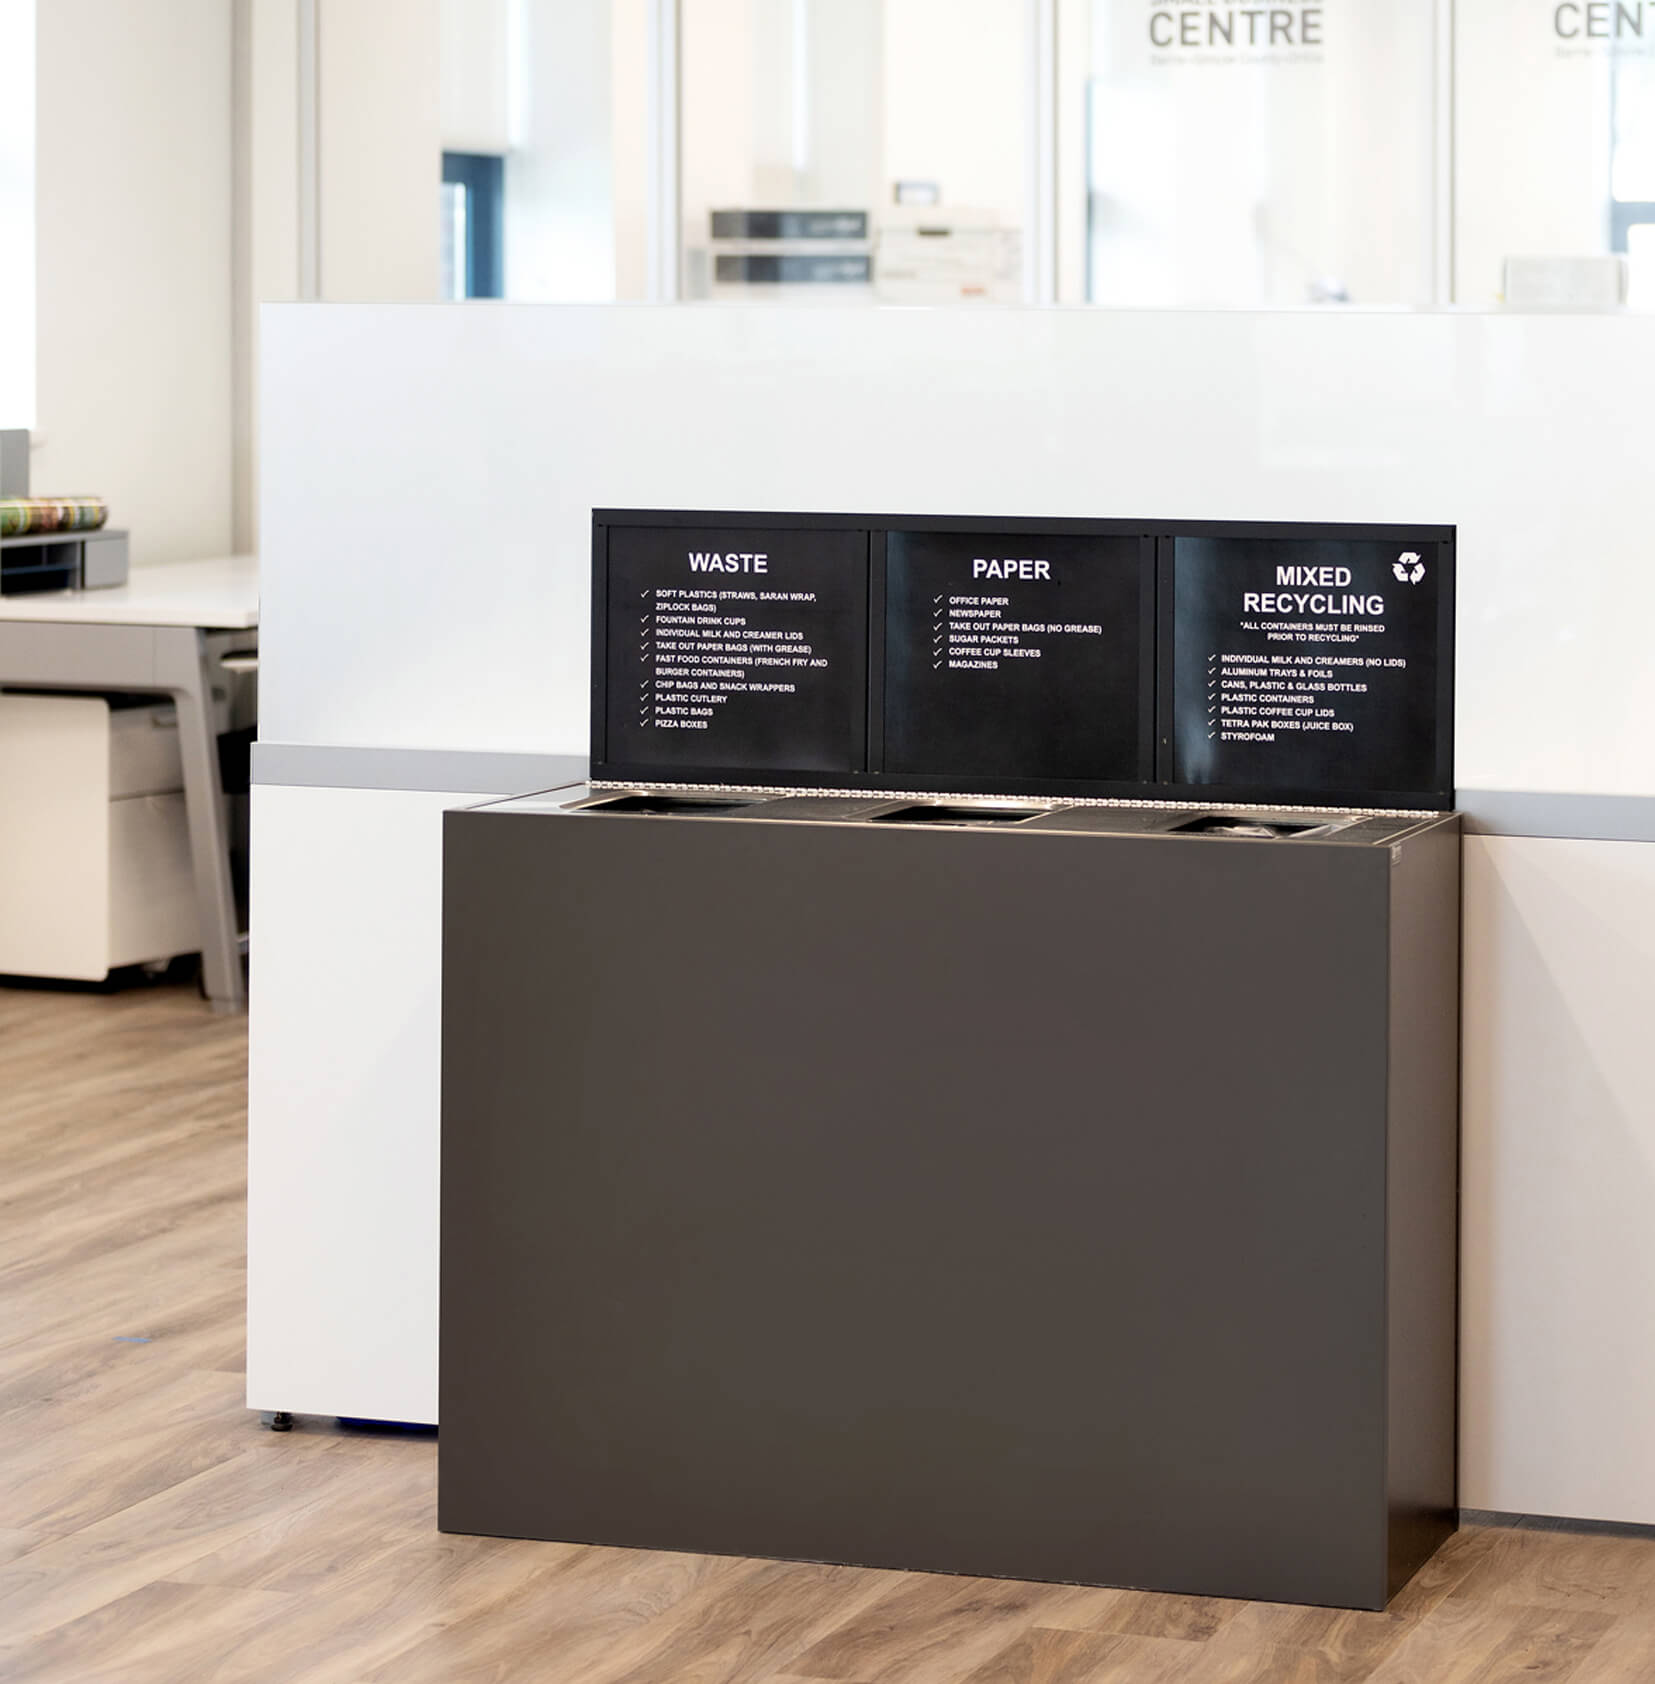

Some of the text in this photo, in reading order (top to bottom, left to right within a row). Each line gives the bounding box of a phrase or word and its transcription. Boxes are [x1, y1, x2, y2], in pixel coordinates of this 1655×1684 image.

[1554, 2, 1655, 38] CEN
[1149, 9, 1323, 47] CENTRE
[689, 552, 768, 573] WASTE
[974, 559, 1050, 579] PAPER
[1277, 566, 1351, 586] MIXED
[679, 590, 717, 599] PLASTICS
[719, 591, 758, 600] (STRAWS,
[760, 592, 788, 600] SARAN
[790, 593, 816, 602] WRAP,
[949, 596, 1008, 605] OFFICE PAPER
[656, 603, 716, 613] ZIPLOCK BAGS)
[1244, 593, 1384, 615] RECYCLING
[949, 609, 1001, 618] NEWSPAPER
[656, 616, 745, 625] FOUNTAIN DRINK CUPS
[949, 622, 971, 630] TAKE
[992, 623, 1020, 631] PAPER
[1022, 624, 1045, 632] BAGS
[1047, 624, 1062, 633] (NO
[1064, 624, 1102, 634] GREASE)
[1261, 622, 1313, 631] CONTAINERS
[1341, 624, 1352, 632] BE
[1354, 624, 1385, 632] RINSED
[656, 629, 700, 637] INDIVIDUAL
[702, 630, 721, 638] MILK
[743, 631, 783, 639] CREAMER
[785, 632, 803, 640] LIDS
[949, 635, 1019, 644] SUGAR PACKETS
[1295, 633, 1306, 641] TO
[656, 641, 812, 655] TAKE OUT PAPER BAGS (WITH GREASE)
[949, 647, 1041, 657] COFFEE CUP SLEEVES
[656, 654, 828, 667] FAST FOOD CONTAINERS (FRENCH FRY AND
[949, 660, 998, 669] MAGAZINES
[1221, 655, 1406, 668] INDIVIDUAL MILK AND CREAMERS (NO LIDS)
[656, 668, 744, 679] BURGER CONTAINERS)
[1221, 667, 1333, 678] ALUMINUM TRAYS & FOILS
[655, 680, 795, 692] CHIP BAGS AND SNACK WRAPPERS
[1221, 680, 1367, 692] CANS, PLASTIC & GLASS BOTTLES
[656, 693, 727, 703] PLASTIC CUTLERY
[1221, 693, 1314, 703] PLASTIC CONTAINERS
[656, 707, 713, 716] PLASTIC BAGS
[1221, 706, 1334, 717] PLASTIC COFFEE CUP LIDS
[656, 720, 707, 729] PIZZA BOXES
[1221, 719, 1353, 732] TETRA PAK BOXES (JUICE BOX)
[1221, 732, 1274, 741] STYROFOAM
